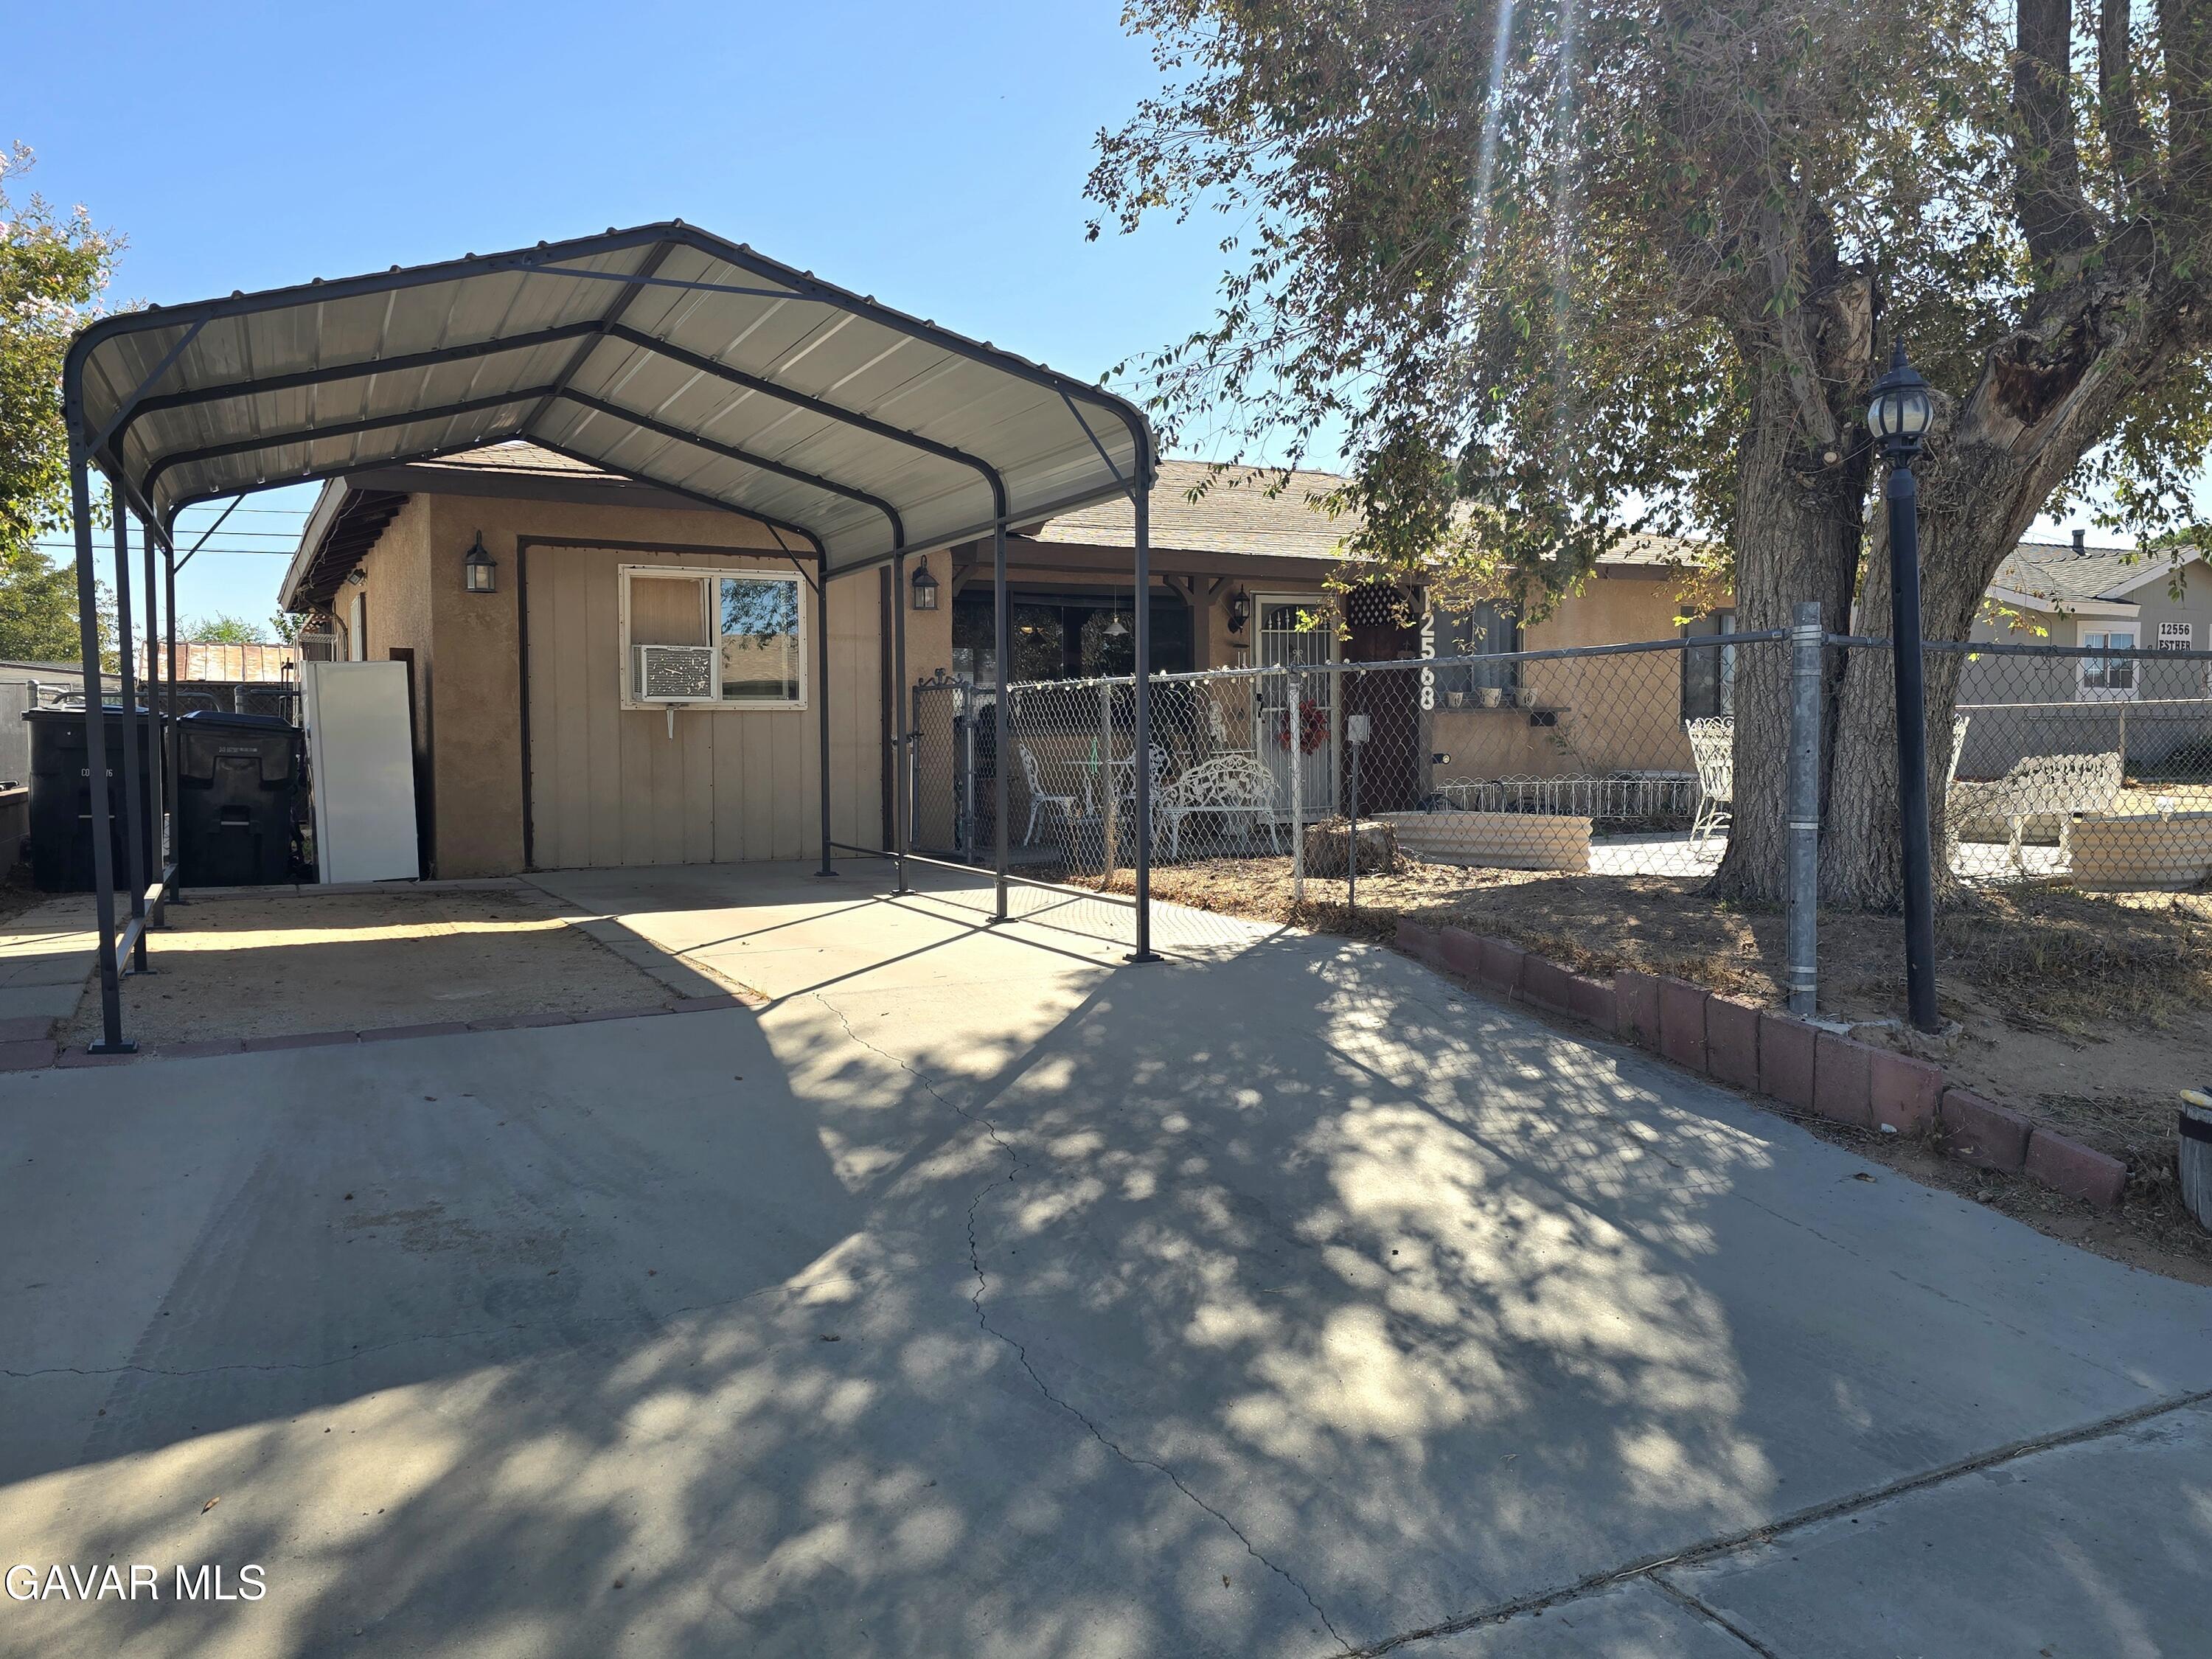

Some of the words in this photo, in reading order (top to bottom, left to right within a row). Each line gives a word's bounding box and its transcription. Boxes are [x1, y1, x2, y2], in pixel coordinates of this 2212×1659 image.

[2161, 623, 2190, 635] 12556
[1420, 586, 1436, 710] 12568
[2159, 639, 2191, 650] ESTHER
